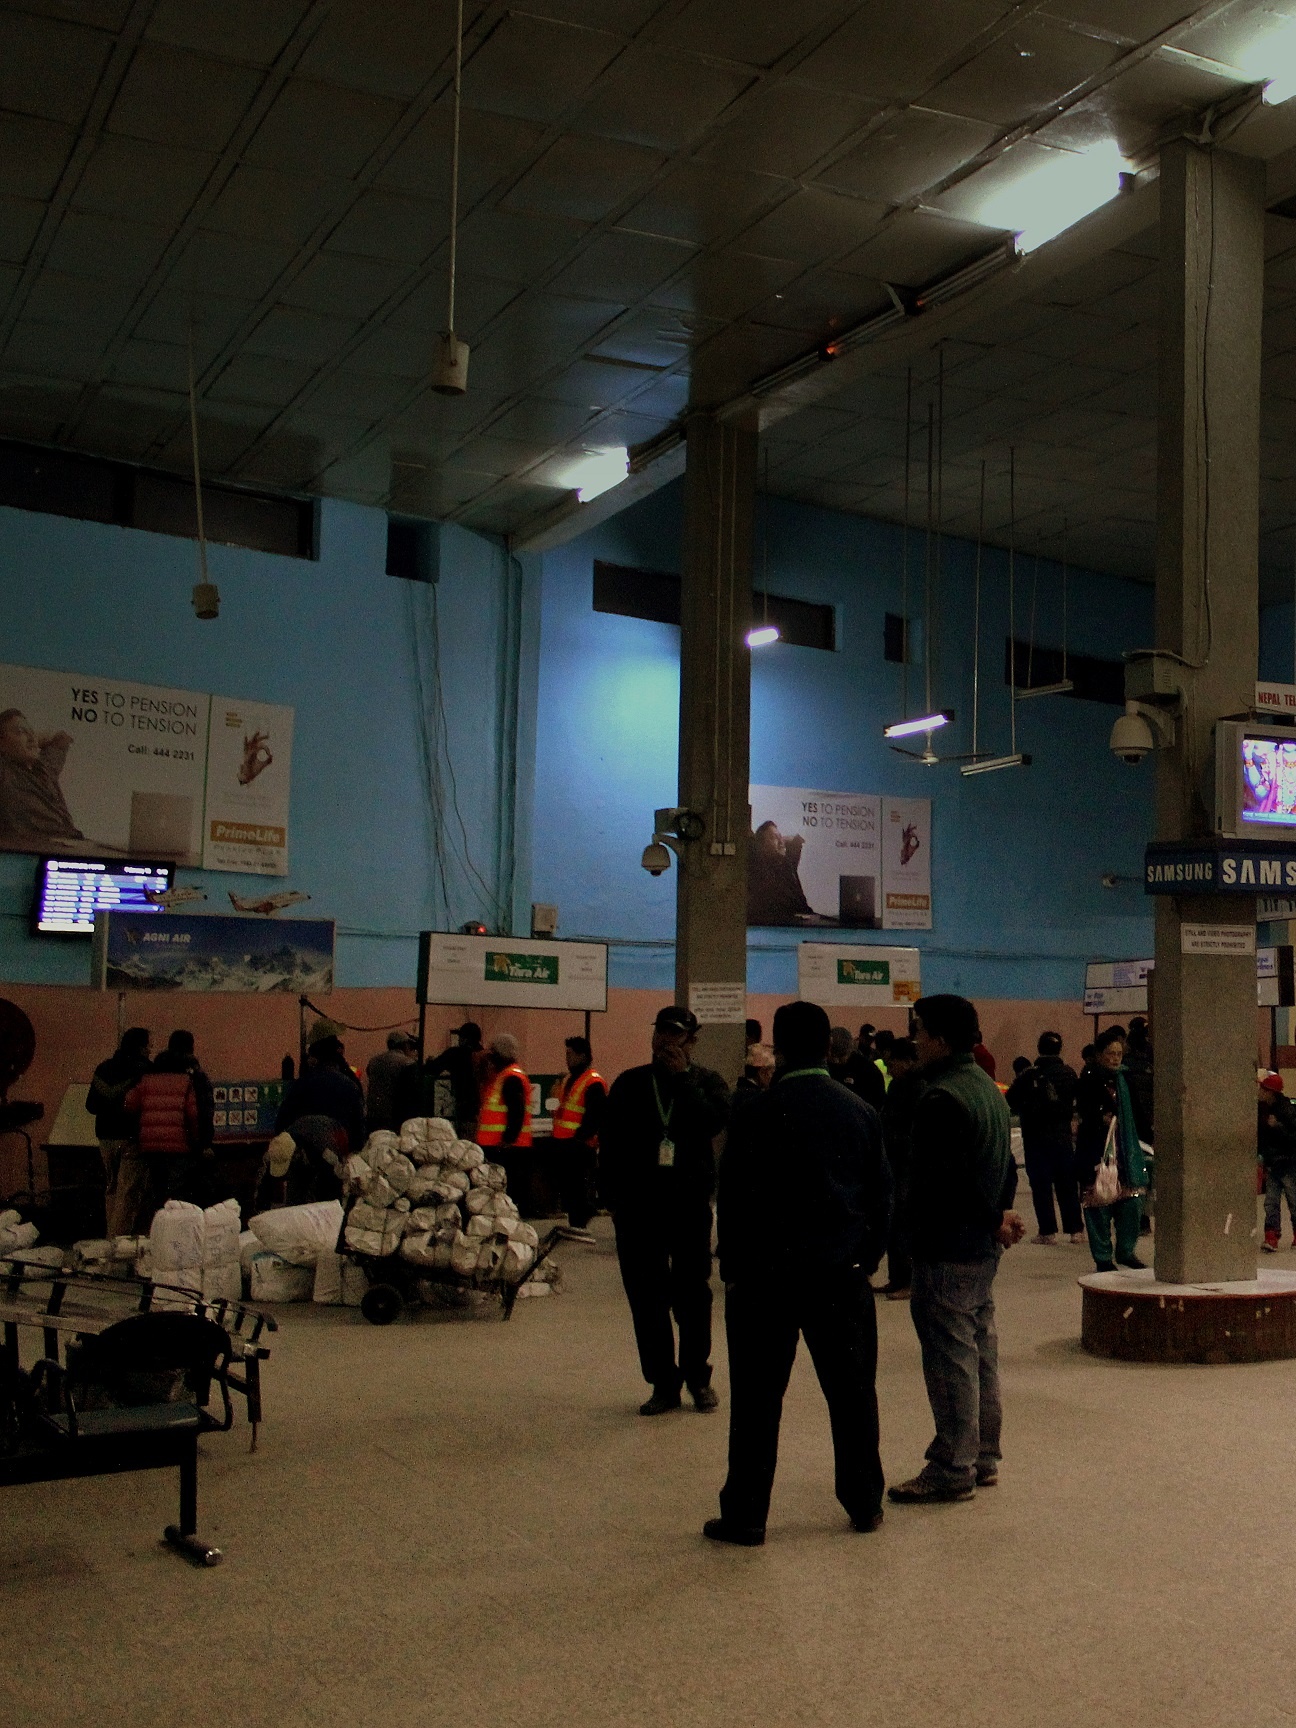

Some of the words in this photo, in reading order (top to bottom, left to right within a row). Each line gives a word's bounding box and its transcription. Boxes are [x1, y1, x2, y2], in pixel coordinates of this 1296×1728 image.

[71, 687, 98, 705] YES
[104, 692, 125, 708] TO
[130, 696, 197, 718] PENSION
[1258, 692, 1280, 705] NEPAL
[71, 707, 98, 723] NO
[102, 709, 125, 727] TO
[129, 714, 197, 736] TENSION
[153, 748, 170, 758] 444
[172, 749, 194, 761] 2231
[802, 802, 818, 813] YES
[820, 802, 833, 815] TO
[835, 804, 875, 817] PENSION
[802, 816, 818, 827] NO
[820, 818, 833, 829] TO
[836, 818, 875, 832] TENSION
[1147, 863, 1213, 883] SAMSUNG
[143, 932, 170, 943] AGNI
[172, 933, 191, 943] AIR
